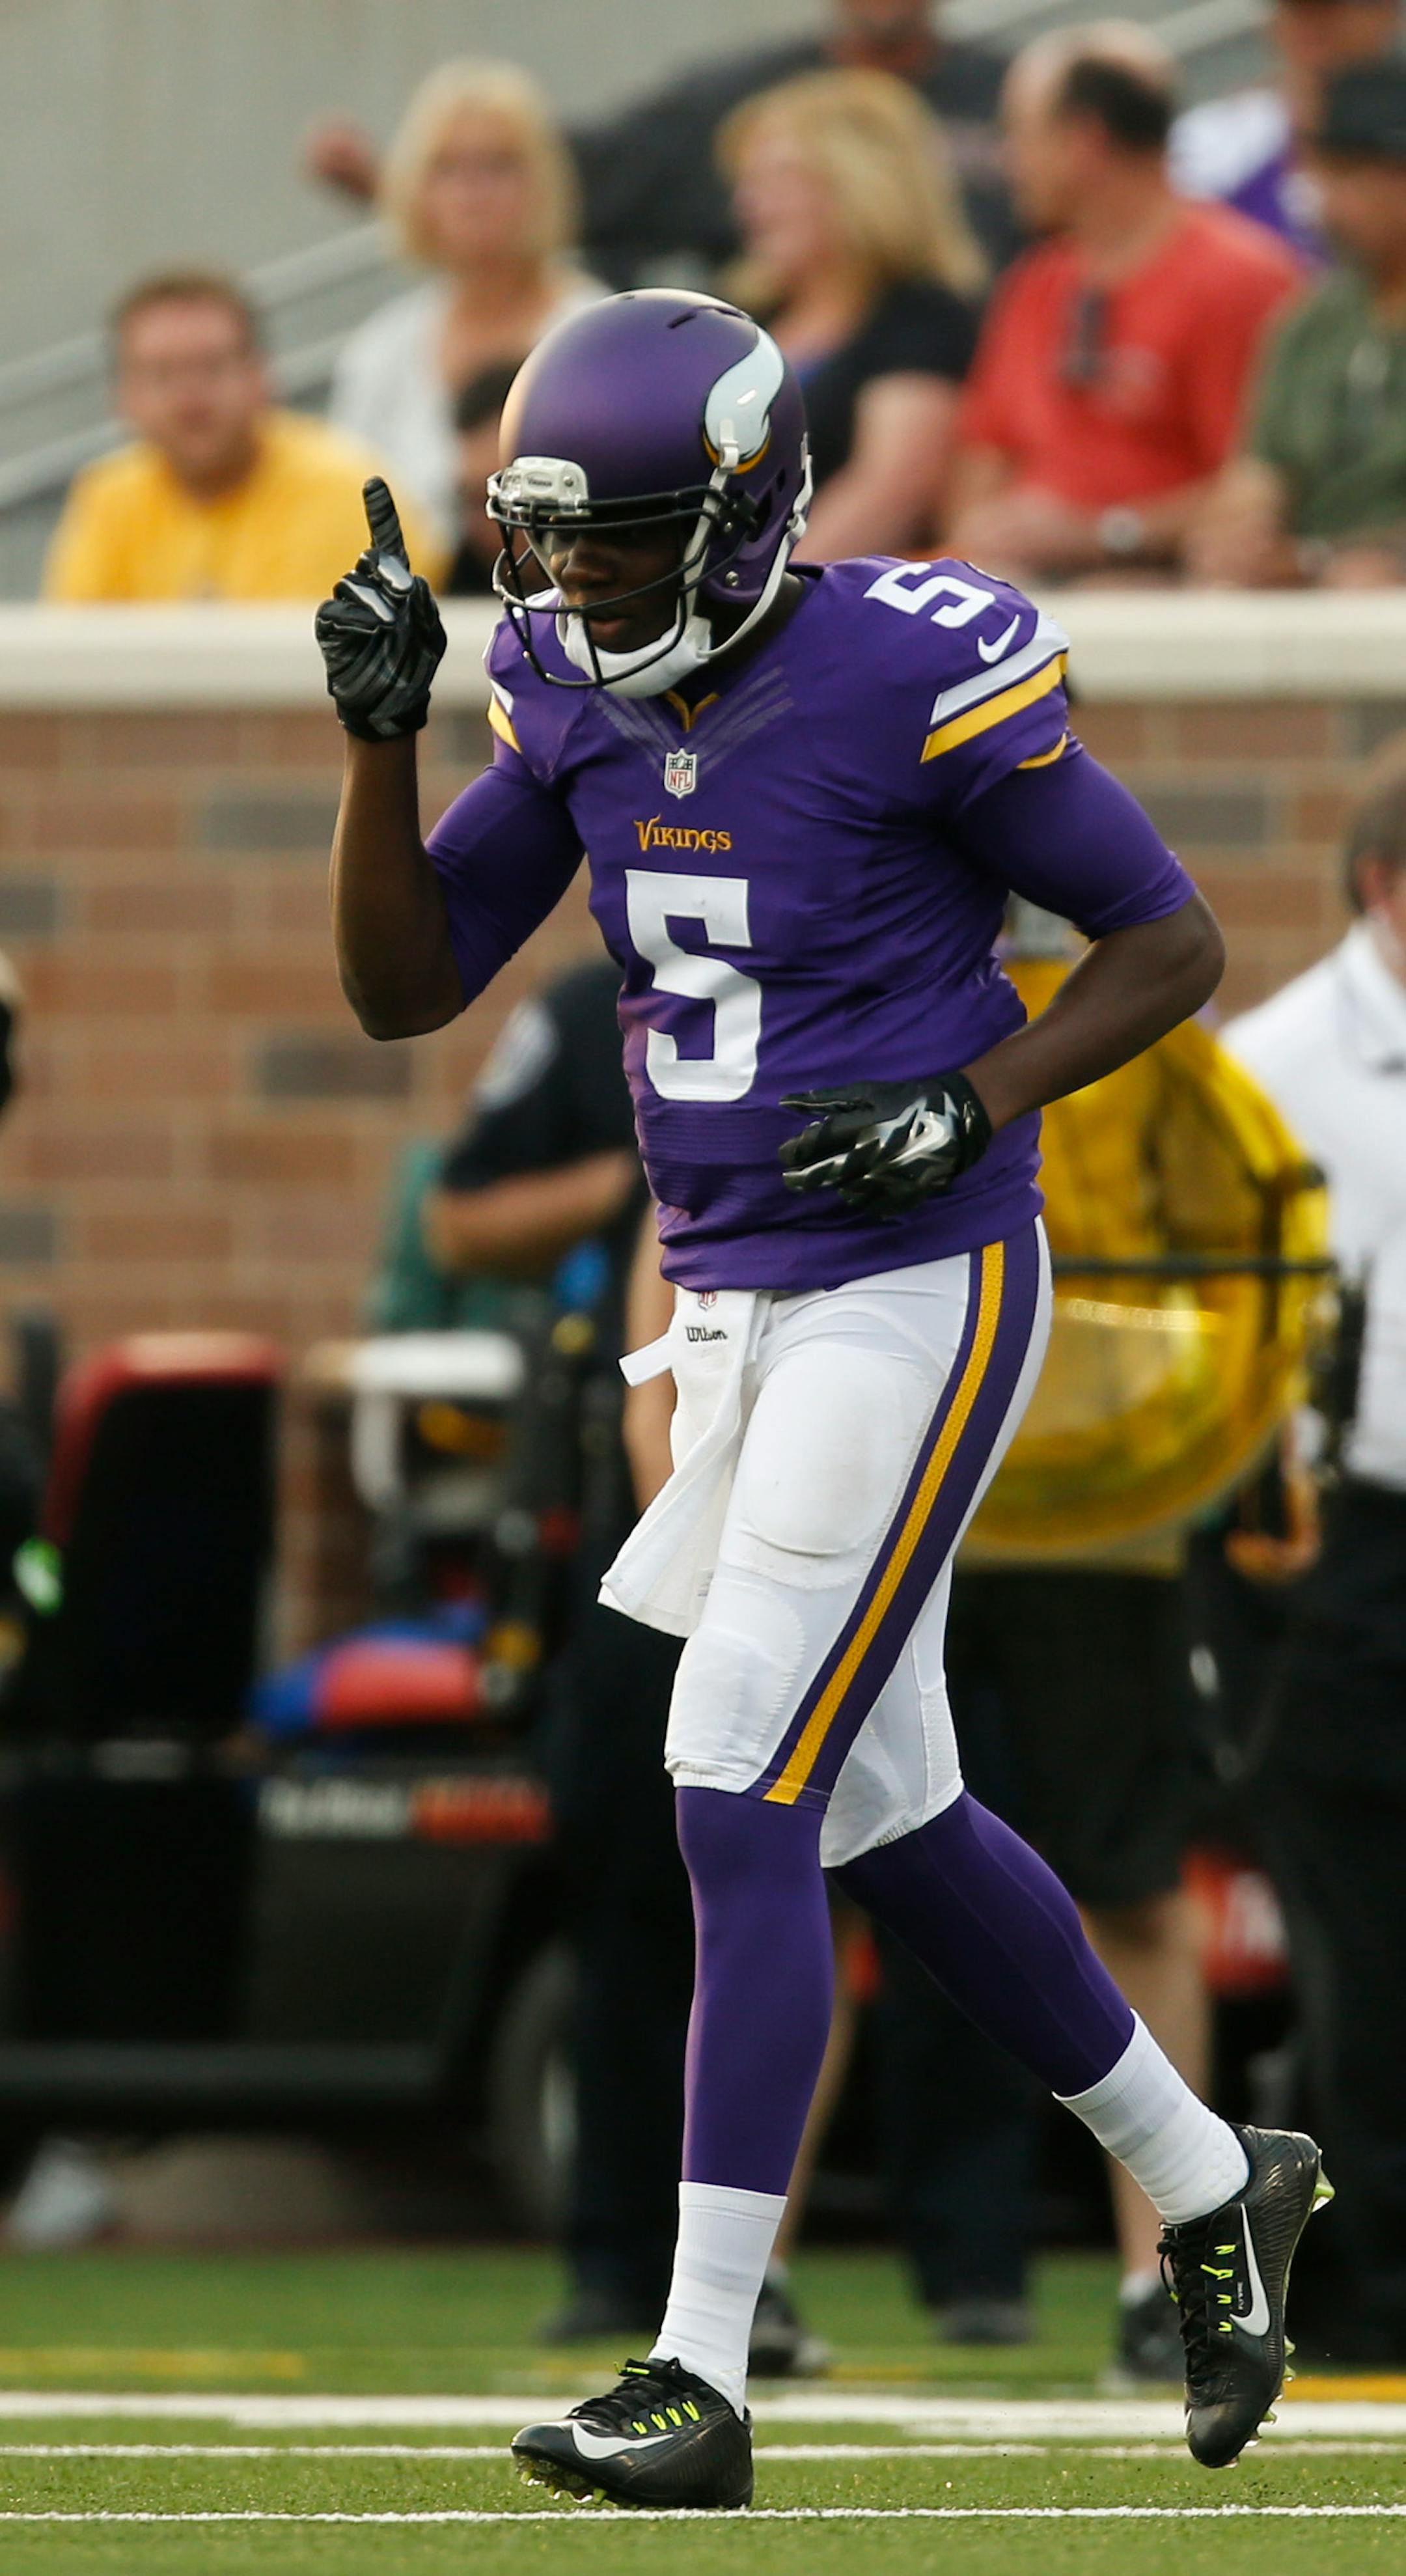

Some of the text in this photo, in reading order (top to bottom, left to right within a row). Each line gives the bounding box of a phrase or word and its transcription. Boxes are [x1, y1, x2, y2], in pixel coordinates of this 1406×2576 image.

[863, 563, 996, 628] 5
[670, 771, 691, 789] NFL
[625, 869, 761, 1101] 5
[685, 1325, 728, 1342] Wilson
